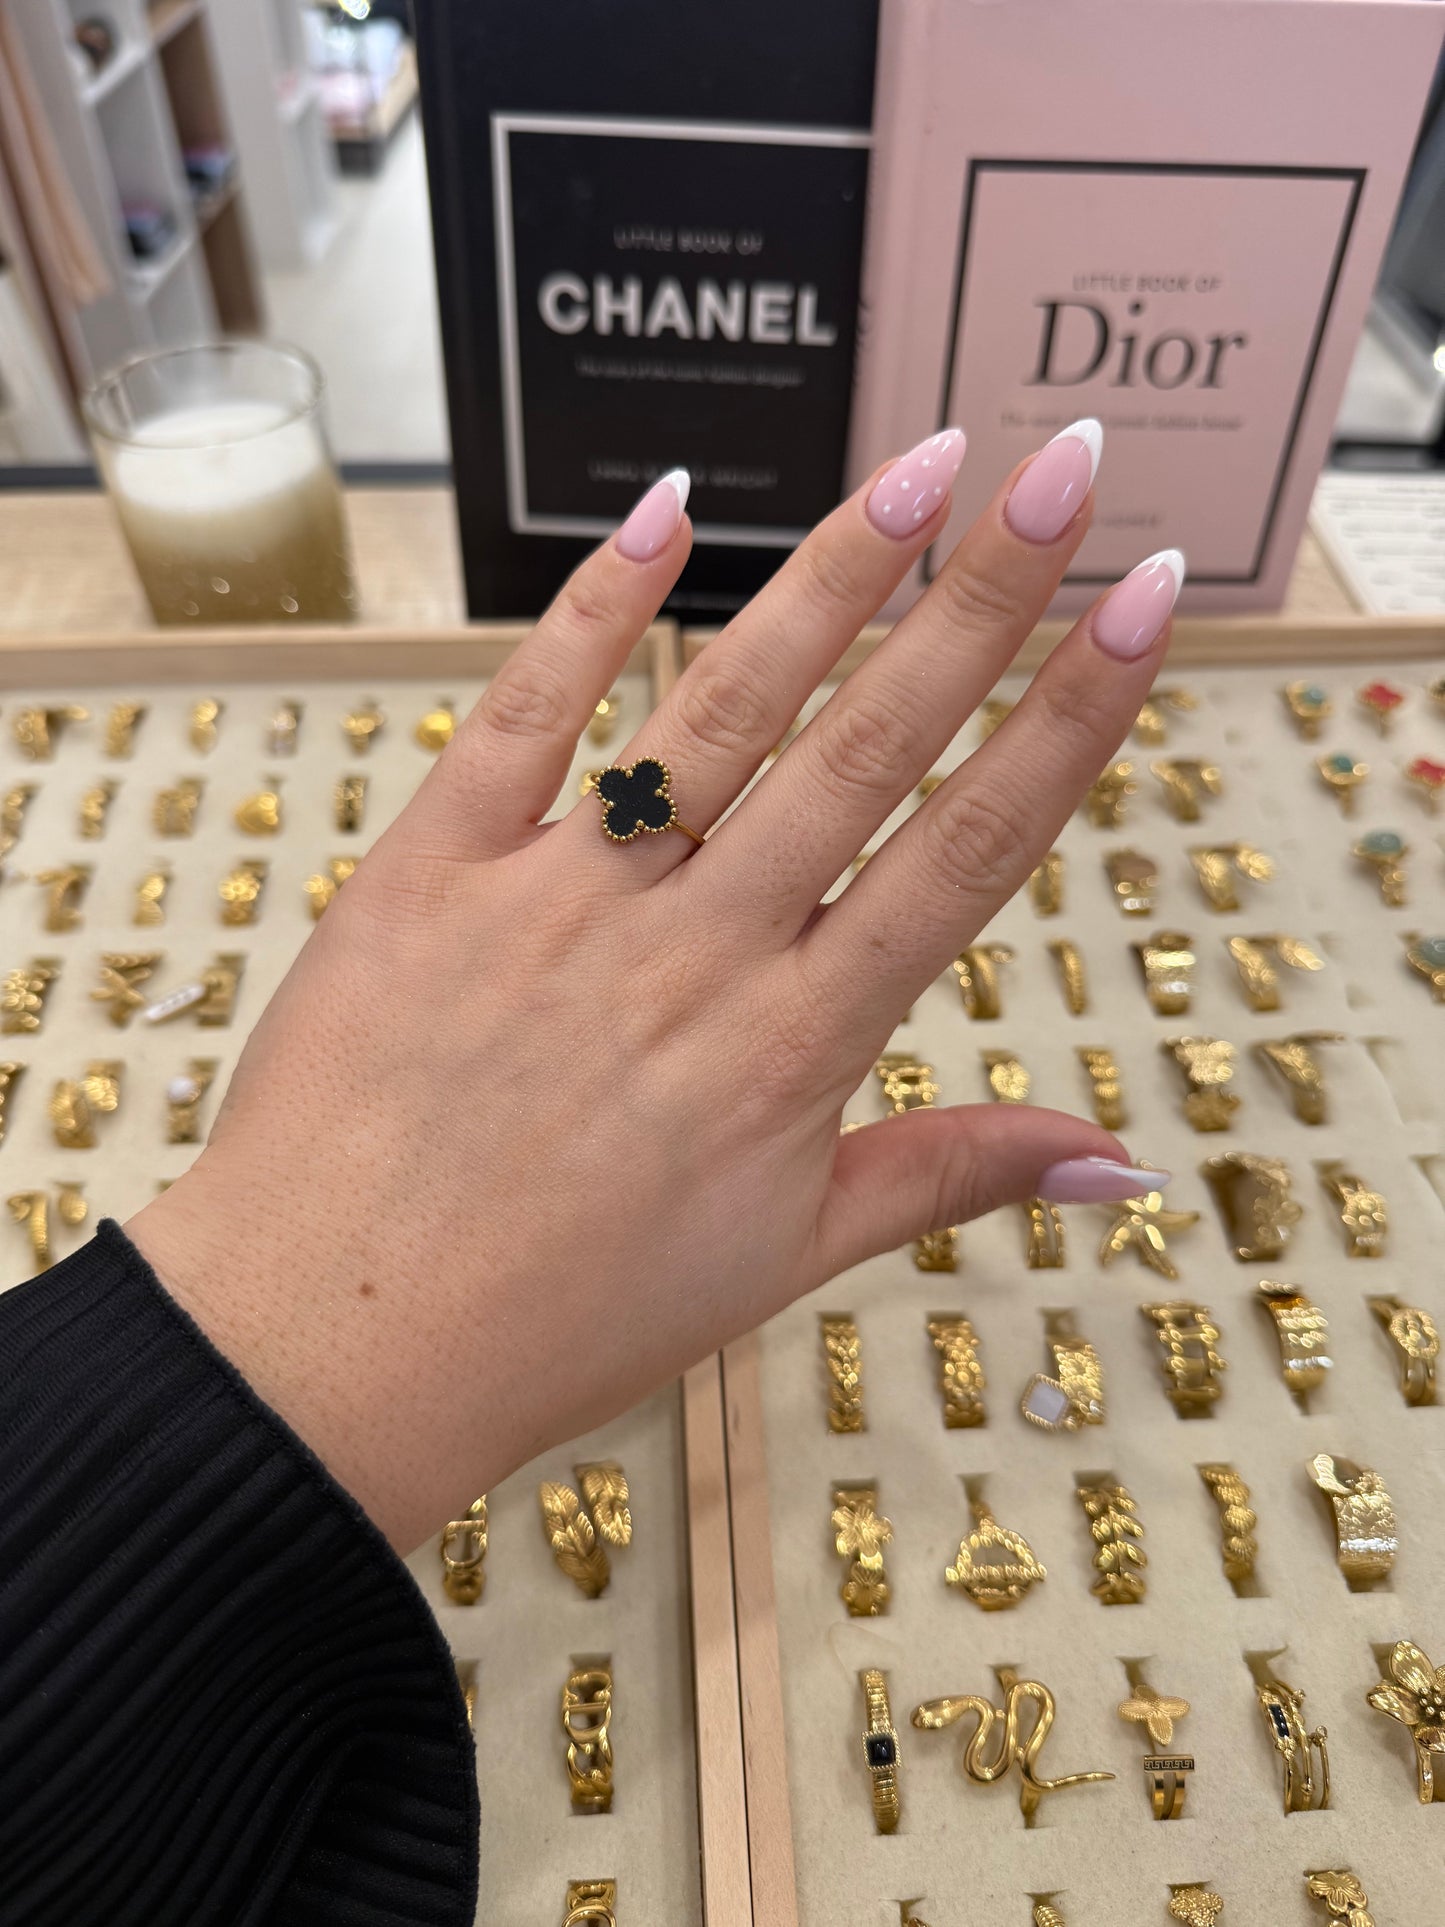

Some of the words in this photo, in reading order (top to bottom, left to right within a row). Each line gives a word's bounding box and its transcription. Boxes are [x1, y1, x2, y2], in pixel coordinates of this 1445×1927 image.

[613, 229, 674, 251] LITTLE
[677, 231, 734, 254] BOOK
[735, 235, 764, 255] OF
[537, 269, 838, 347] CHANEL
[1072, 272, 1132, 292] LITTLE
[1135, 273, 1191, 293] BOOK
[1194, 275, 1222, 293] OF
[1020, 296, 1249, 390] Dior
